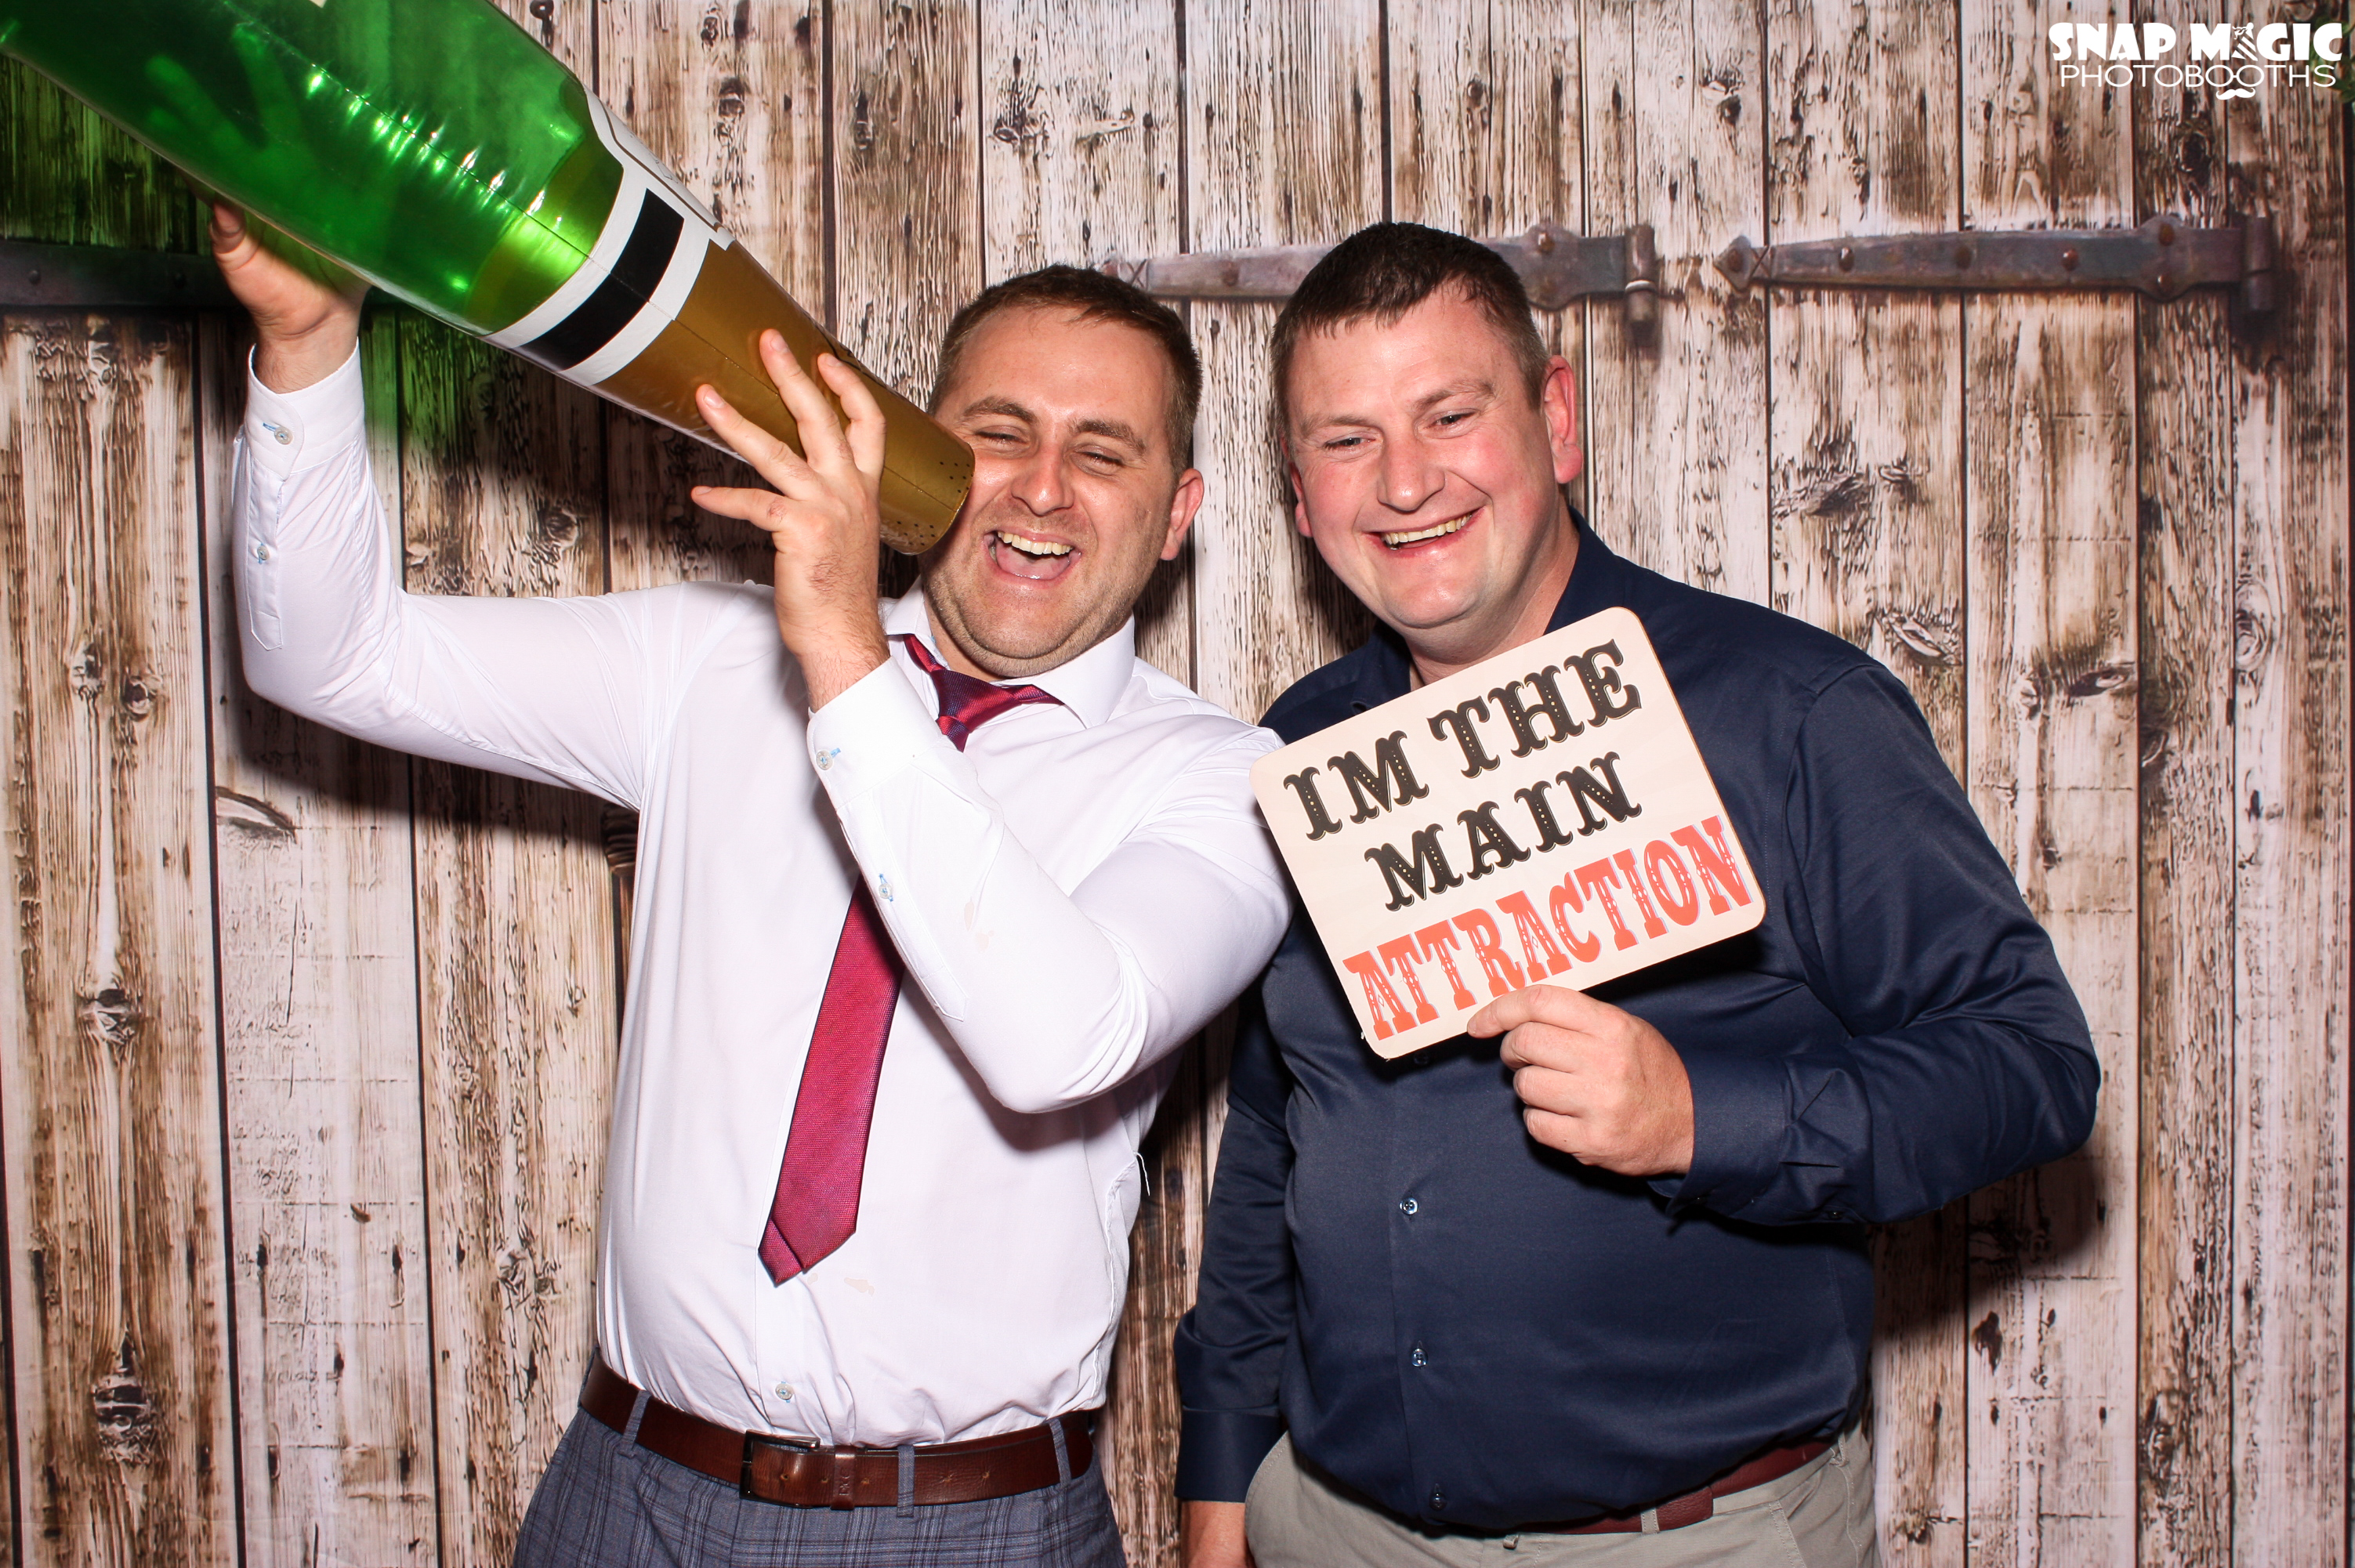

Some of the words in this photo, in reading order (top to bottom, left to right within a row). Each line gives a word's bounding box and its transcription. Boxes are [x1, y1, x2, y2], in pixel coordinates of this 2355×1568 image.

[1283, 730, 1429, 841] IM
[1427, 638, 1643, 779] THE
[1364, 751, 1643, 912] MAIN
[1342, 815, 1752, 1041] ATTRACTION
